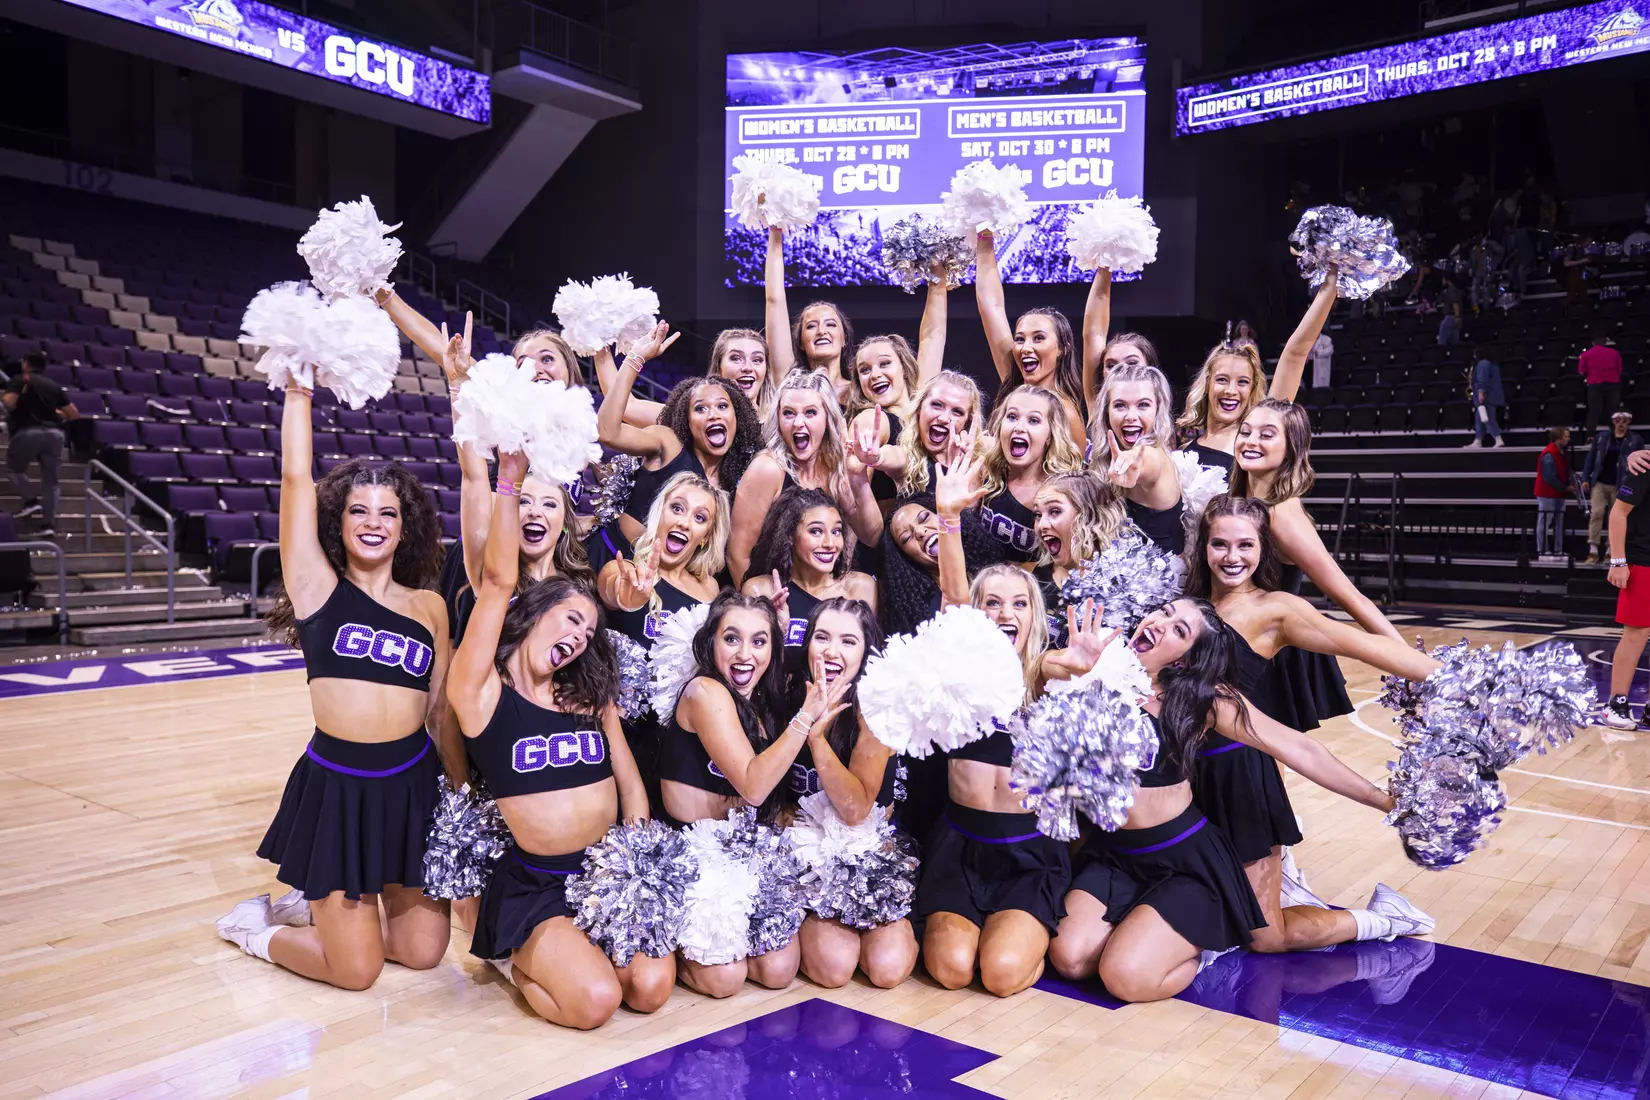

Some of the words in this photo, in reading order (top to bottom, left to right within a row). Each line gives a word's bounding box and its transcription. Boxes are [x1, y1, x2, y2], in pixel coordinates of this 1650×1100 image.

[277, 27, 305, 53] VS
[1437, 52, 1470, 71] OCT
[1474, 47, 1495, 64] 28
[1514, 40, 1526, 56] 6
[1530, 34, 1557, 53] PM
[1564, 44, 1609, 59] WESTERN
[324, 35, 415, 97] GCU
[1193, 92, 1261, 118] WOMEN'S
[1263, 73, 1363, 105] BASKETBALL
[744, 118, 814, 136] WOMEN'S
[817, 115, 915, 134] BASKETBALL
[956, 111, 1007, 129] MEN'S
[1010, 108, 1118, 128] BASKETBALL
[803, 146, 834, 162] OCT
[886, 144, 909, 160] PM
[961, 141, 995, 158] SAT,
[999, 140, 1030, 156] OCT
[1033, 139, 1054, 155] 30
[1086, 137, 1110, 153] PM
[61, 160, 114, 197] 102
[832, 163, 901, 195] GCU
[1042, 157, 1114, 189] GCU
[332, 622, 433, 678] GCU
[512, 730, 605, 773] GCU
